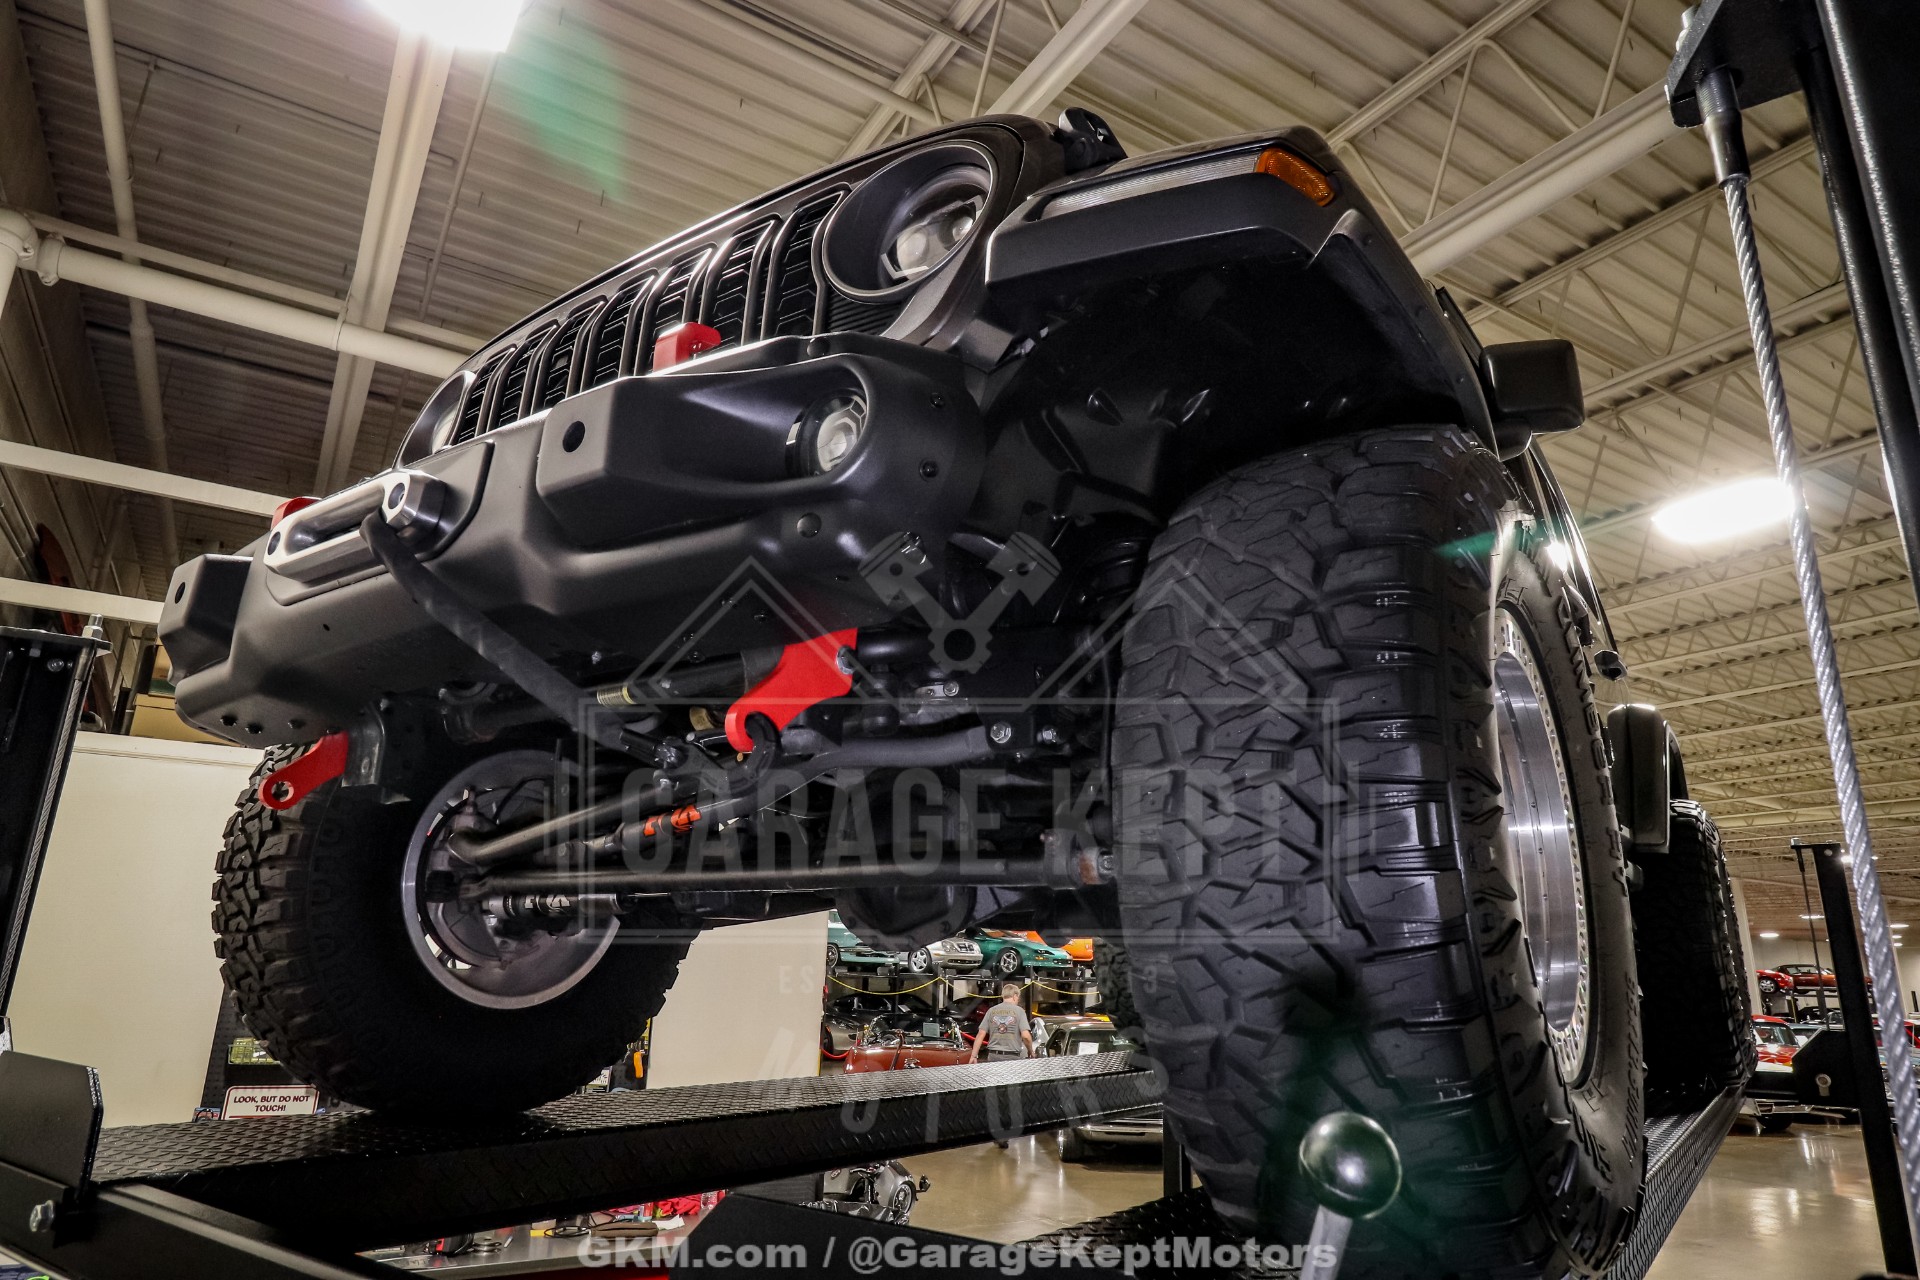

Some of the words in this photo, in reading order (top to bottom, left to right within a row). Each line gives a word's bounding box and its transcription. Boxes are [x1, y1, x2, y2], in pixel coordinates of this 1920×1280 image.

[234, 1095, 258, 1104] LOOK,
[260, 1095, 277, 1103] BUT
[278, 1095, 291, 1103] DO
[255, 1104, 286, 1112] TOUCH!
